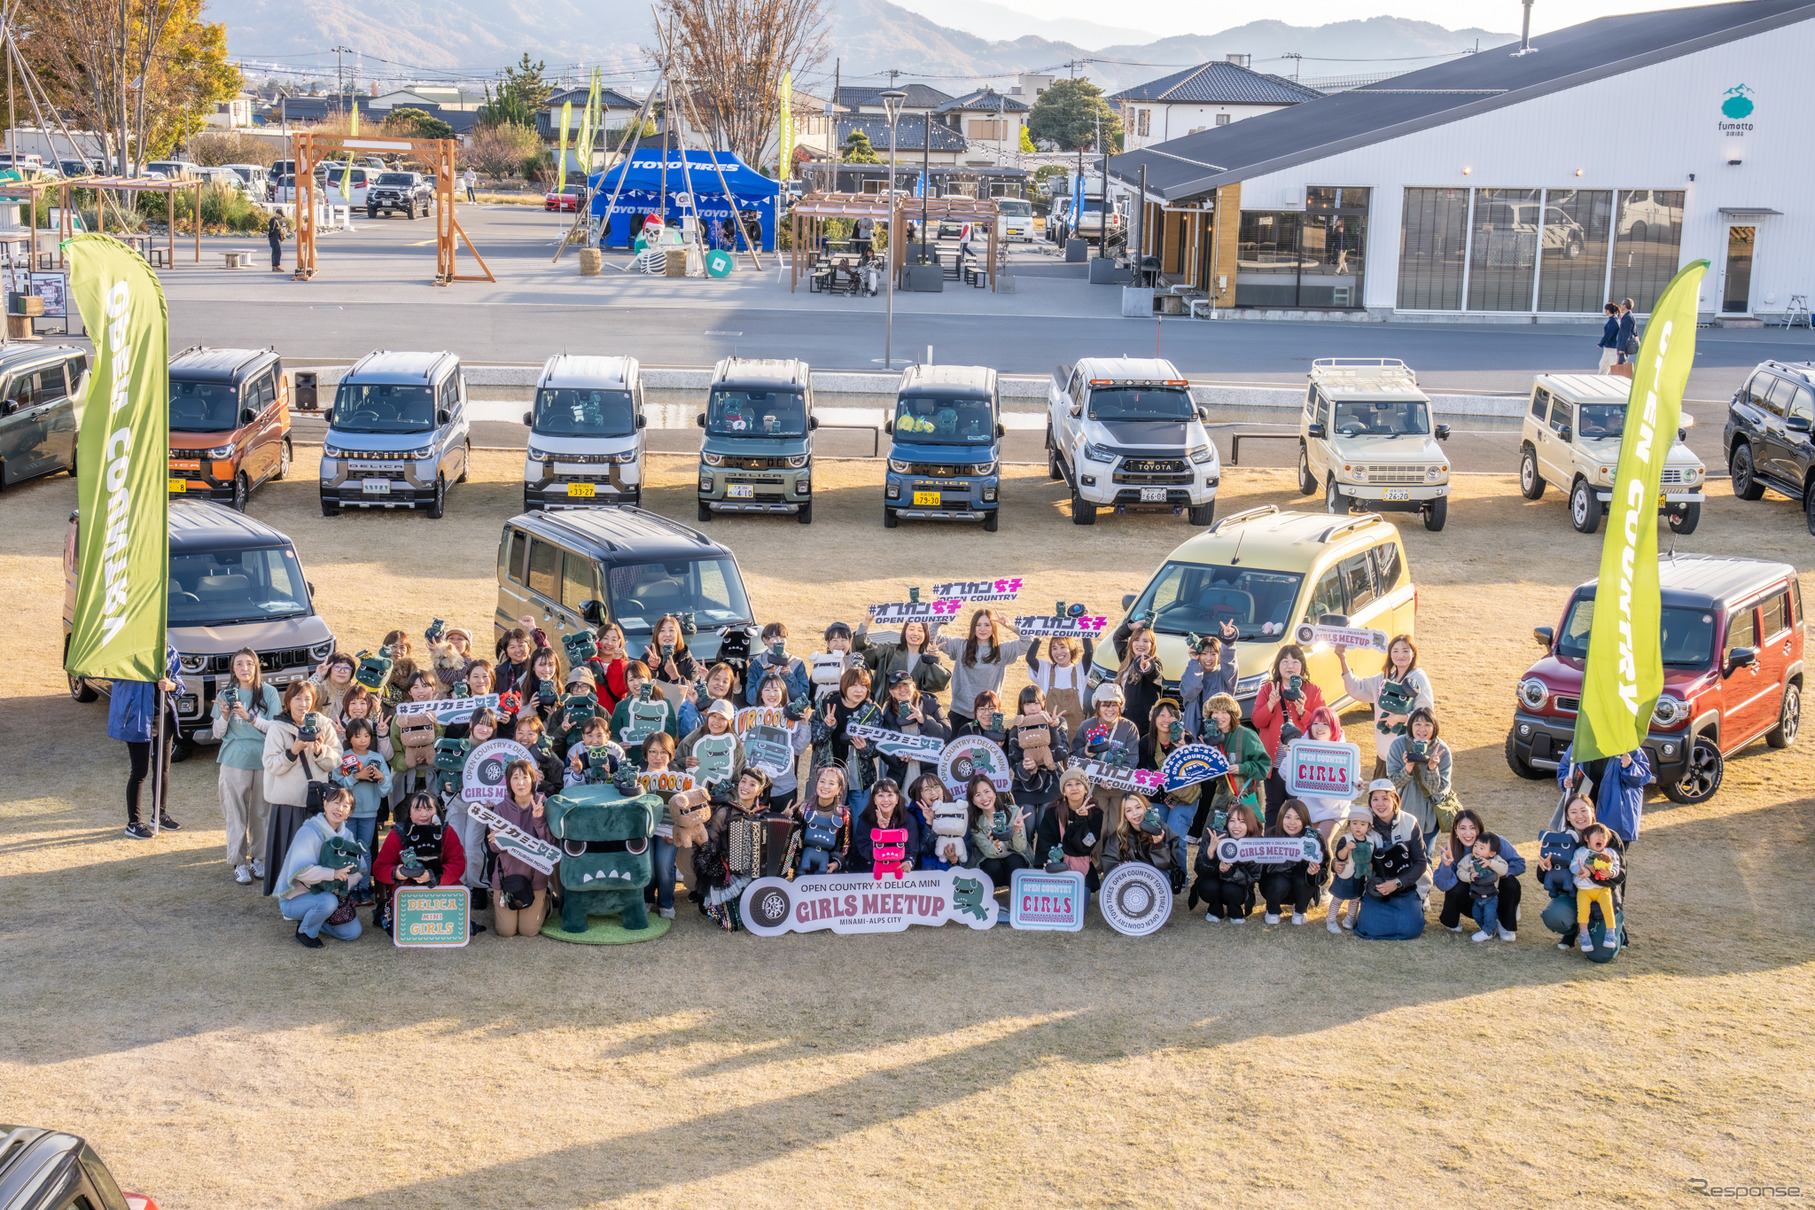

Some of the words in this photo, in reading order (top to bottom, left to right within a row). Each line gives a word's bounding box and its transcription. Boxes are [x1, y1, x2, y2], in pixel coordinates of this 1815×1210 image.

[1718, 121, 1754, 131] fumotto
[631, 160, 682, 170] TOYO
[684, 161, 740, 172] TIRES
[698, 209, 728, 218] TOYO
[106, 280, 131, 414] OPEN
[102, 426, 132, 649] COUNTRY
[970, 594, 1018, 602] COUNTRY
[1618, 478, 1645, 716] COUNTRY
[875, 616, 904, 624] OPEN
[907, 615, 956, 623] COUNTRY
[1020, 629, 1049, 637] OPEN
[1052, 630, 1101, 638] COUNTRY
[1338, 633, 1370, 647] MEETUP
[943, 738, 972, 762] COUNTRY
[976, 738, 999, 756] DELICA
[465, 760, 477, 781] OPEN
[474, 741, 508, 760] COUNTRY
[512, 744, 533, 761] DELIC
[1171, 759, 1184, 775] OPEN
[1182, 753, 1213, 763] COUNTRY
[1299, 752, 1316, 762] OPEN
[1316, 753, 1348, 765] COUNTRY
[940, 762, 949, 782] OPEN
[1298, 763, 1347, 784] GIRLS
[637, 774, 693, 793] ROOOOM
[950, 782, 969, 797] IRLS
[464, 786, 494, 799] GIRLS
[1240, 846, 1265, 858] GIRLS
[1266, 846, 1301, 858] MEETUP
[533, 859, 551, 873] MOTORS
[1112, 872, 1127, 886] OPEN
[1126, 869, 1155, 881] COUNTRY
[800, 884, 827, 893] OPEN
[829, 882, 874, 892] COUNTRY
[884, 880, 917, 889] DELICA
[918, 880, 940, 888] MINI
[1023, 883, 1041, 893] OPEN
[1041, 884, 1073, 894] COUNTRY
[1153, 879, 1165, 895] TOYO
[1106, 885, 1115, 904] TIRES
[407, 898, 458, 911] DELICA
[795, 894, 858, 924] GIRLS
[862, 893, 945, 917] MEETUP
[1022, 895, 1072, 914] GIRLS
[1157, 895, 1166, 914] TIRES
[421, 913, 443, 921] MINI
[1107, 904, 1119, 920] TOYO
[839, 917, 886, 926] MINAMI-ALPS
[887, 916, 902, 924] CITY
[1117, 918, 1145, 930] COUNTRY
[1145, 913, 1160, 927] OPEN
[410, 922, 454, 935] GIRLS
